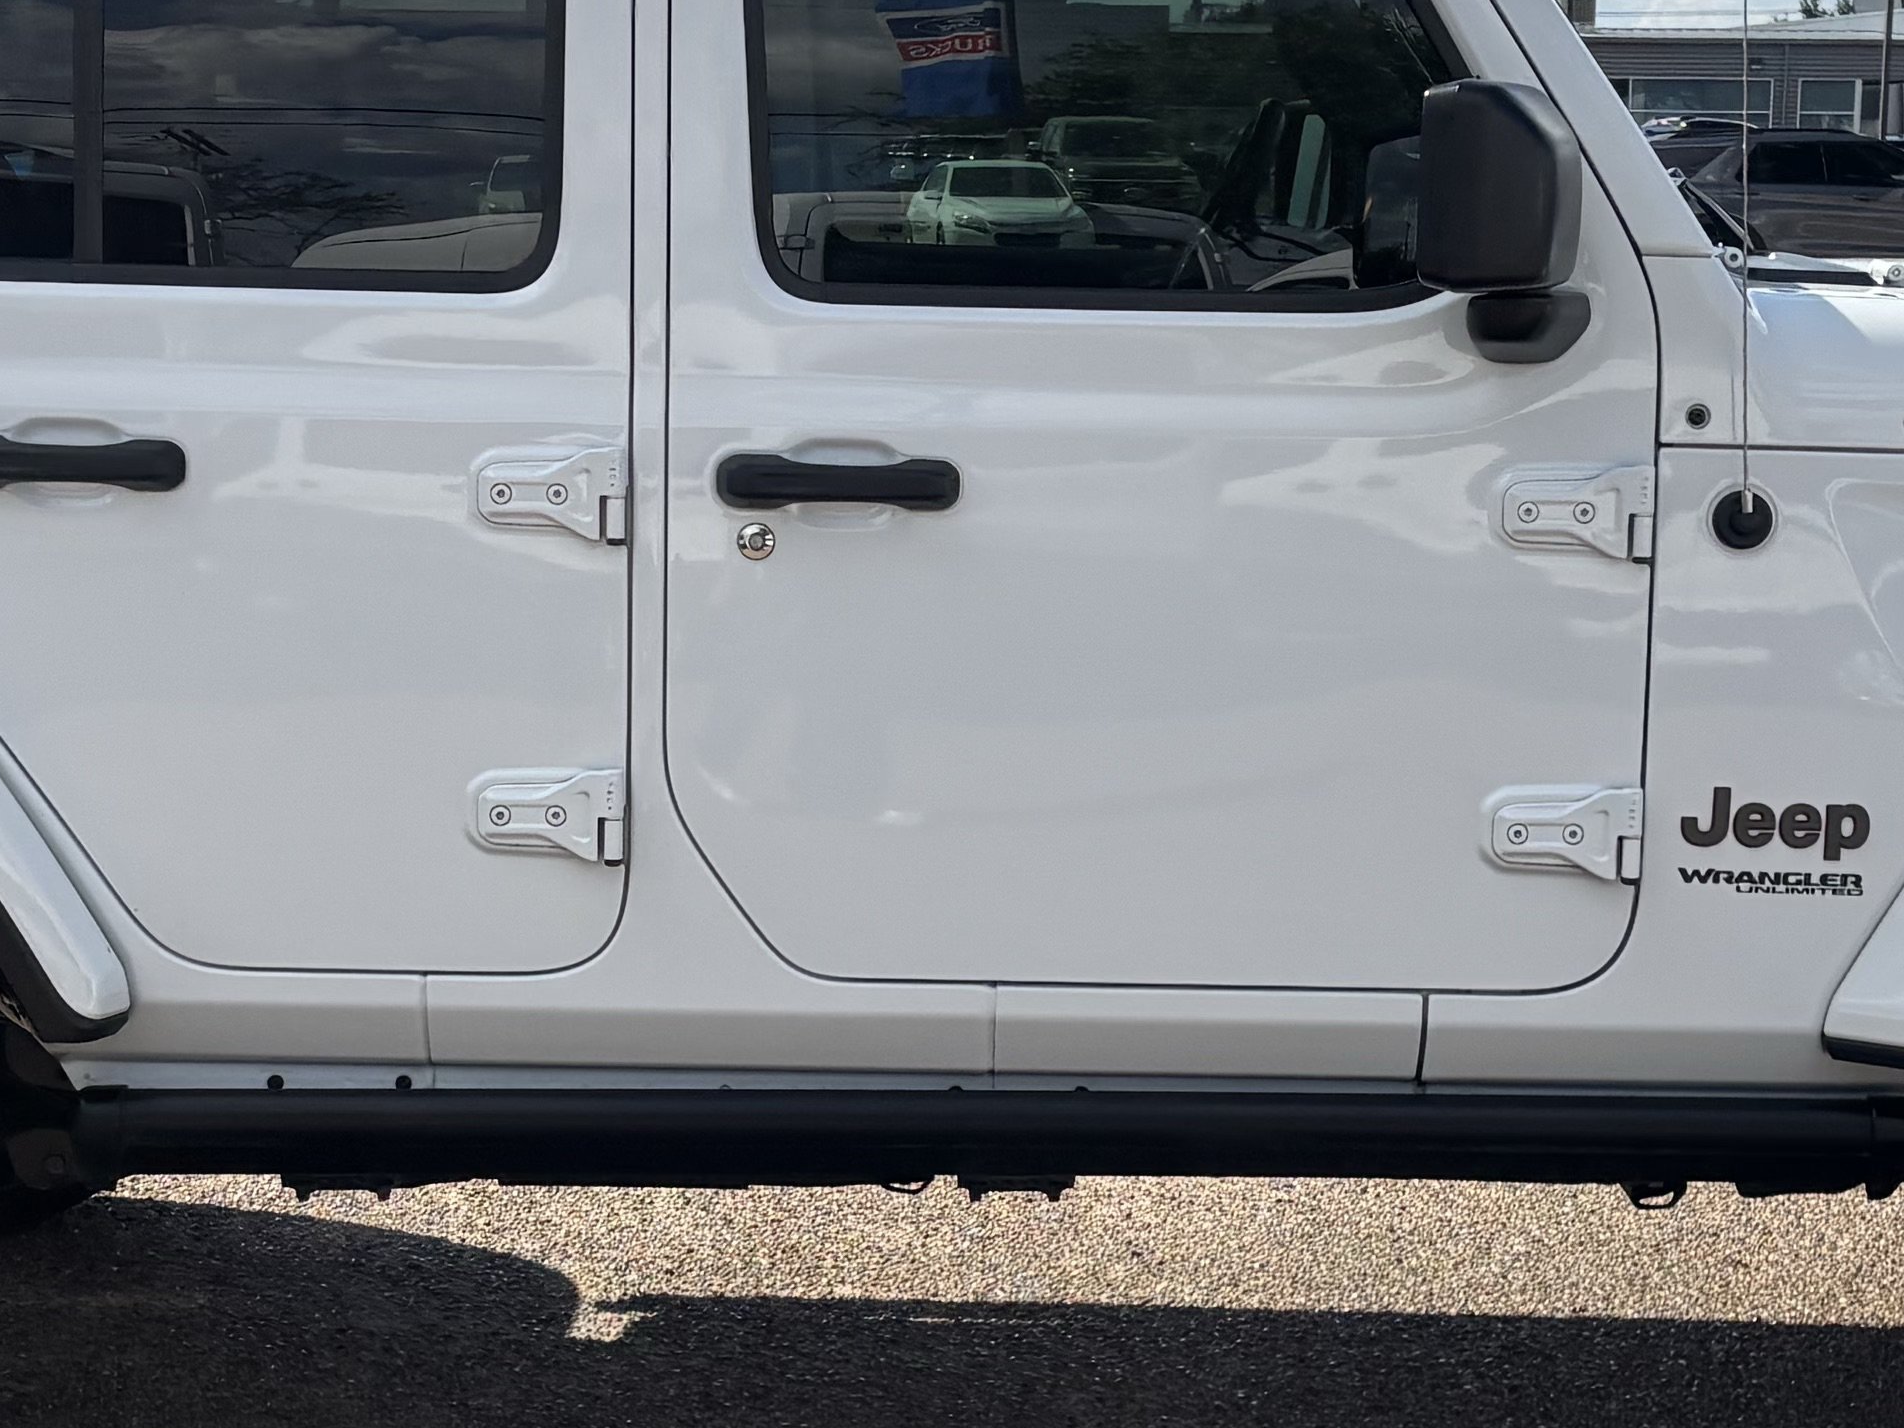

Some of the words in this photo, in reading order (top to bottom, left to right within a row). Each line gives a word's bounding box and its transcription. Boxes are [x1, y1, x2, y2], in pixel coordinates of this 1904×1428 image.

[1680, 786, 1871, 861] Jeep
[1678, 867, 1864, 888] WRANGLER
[1735, 885, 1864, 897] UNLIMITED
